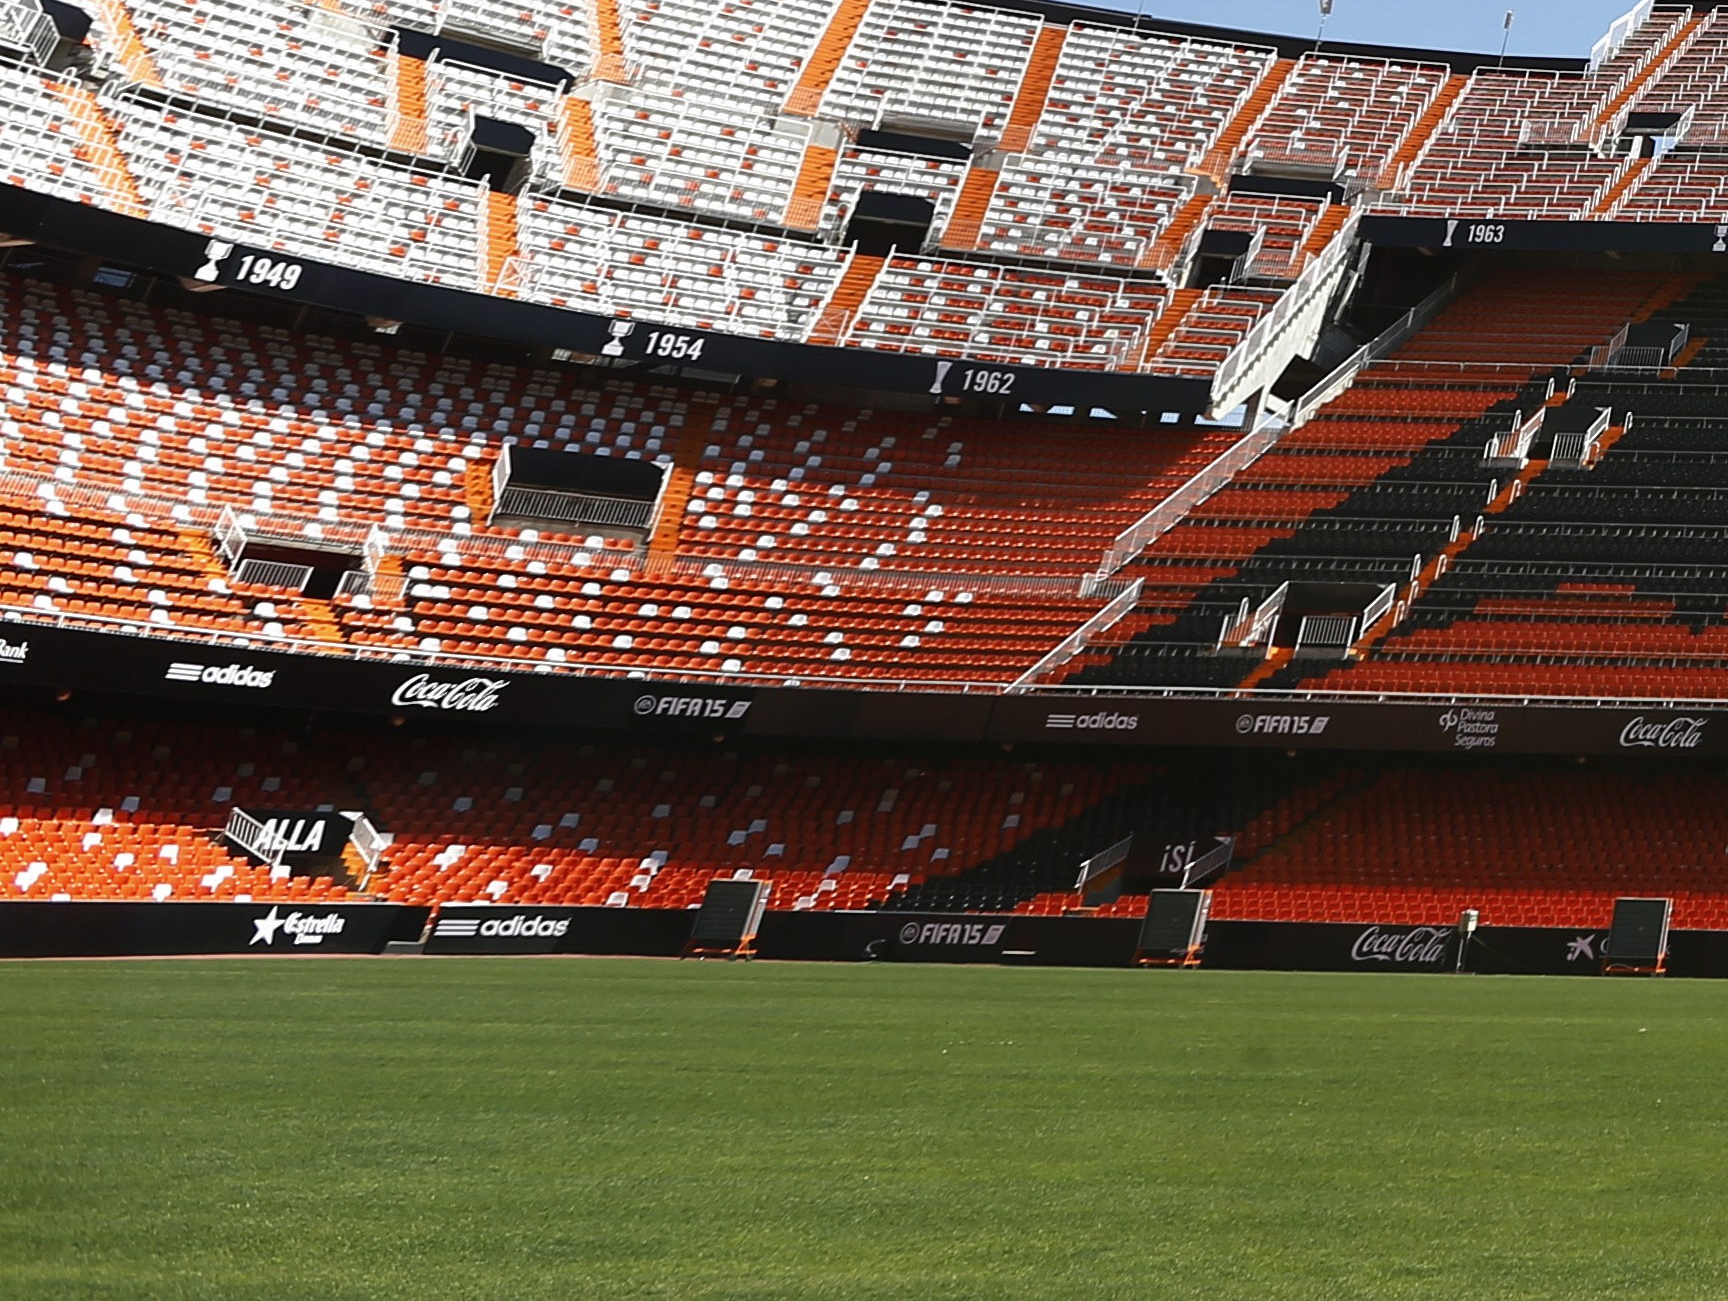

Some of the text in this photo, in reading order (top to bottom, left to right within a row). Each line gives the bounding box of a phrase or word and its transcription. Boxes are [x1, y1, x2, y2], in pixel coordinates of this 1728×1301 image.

[1468, 225, 1504, 242] 1963
[237, 256, 302, 289] 1949
[646, 333, 704, 360] 1954
[963, 370, 1015, 394] 1962
[203, 664, 275, 687] adidas
[1077, 712, 1138, 729] adidas
[1460, 709, 1495, 722] Divina
[1458, 722, 1499, 736] Pastora
[1454, 736, 1496, 749] Seguros
[254, 819, 326, 852] ALLA
[285, 912, 345, 934] Estrella
[480, 916, 570, 936] adidas
